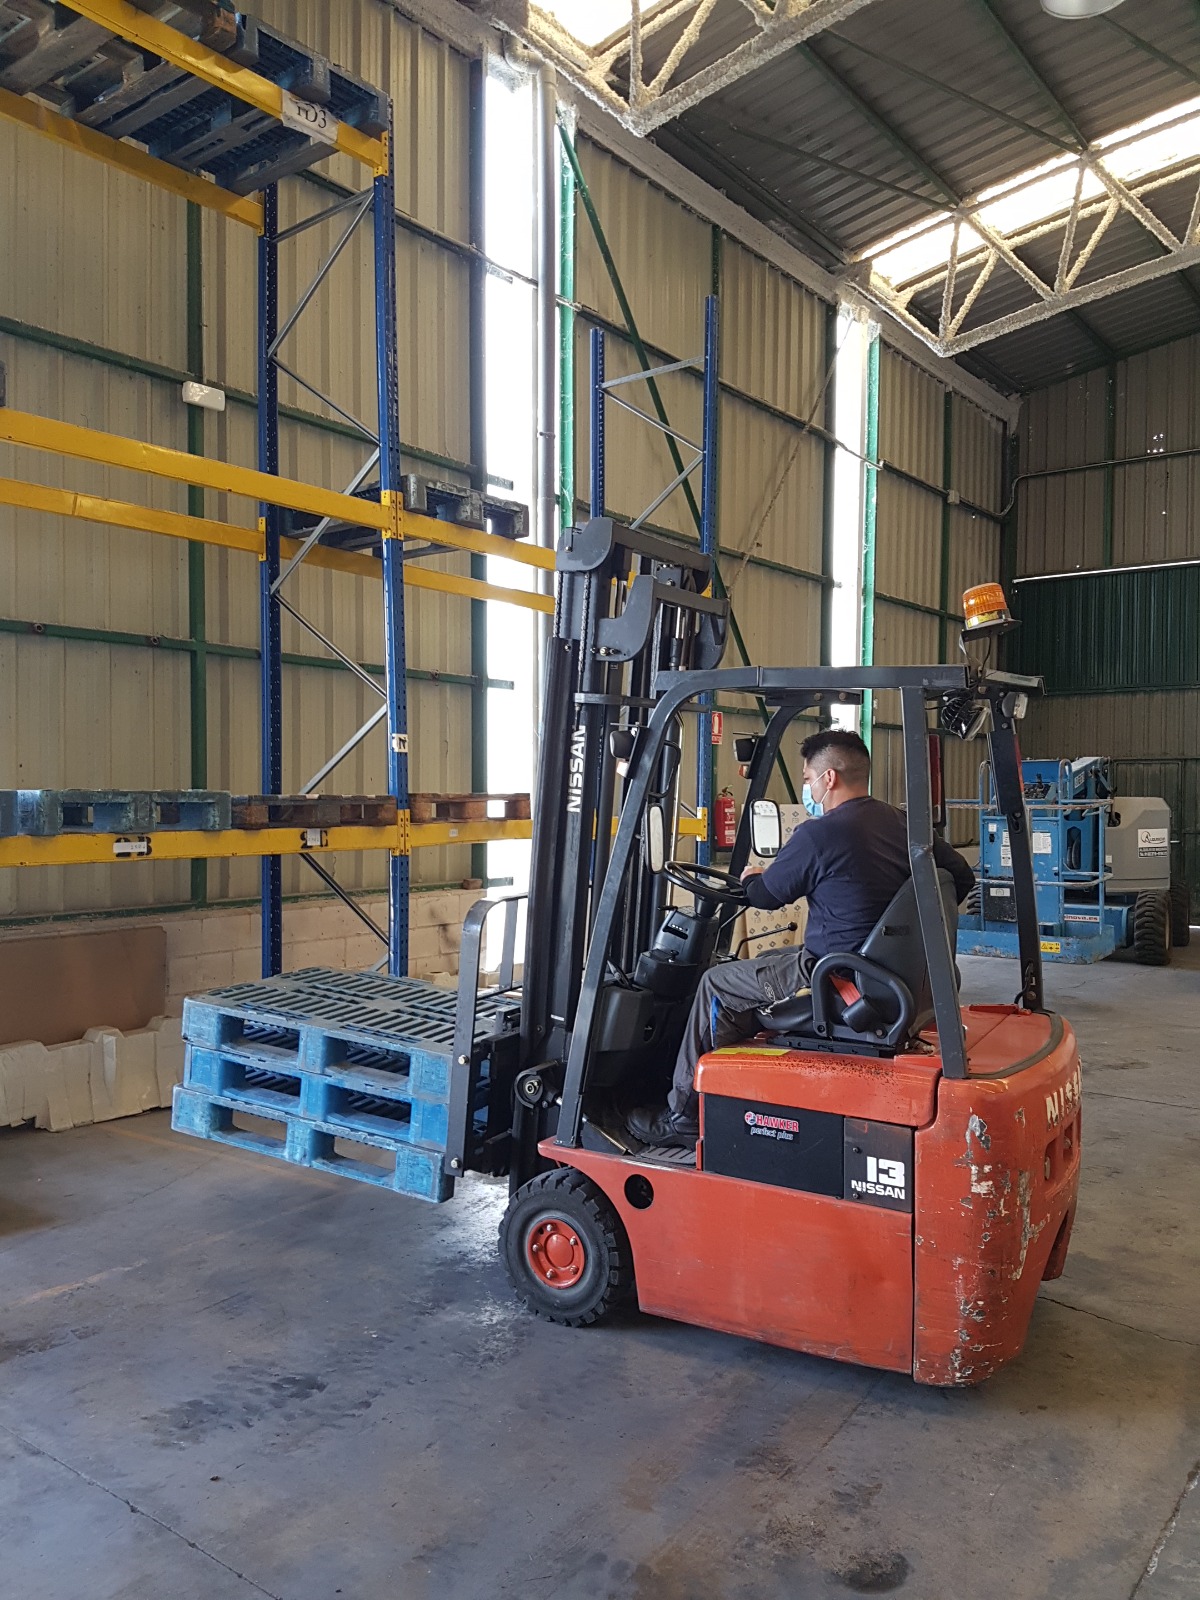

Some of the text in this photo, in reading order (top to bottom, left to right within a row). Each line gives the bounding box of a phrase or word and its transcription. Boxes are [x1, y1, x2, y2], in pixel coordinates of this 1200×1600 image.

[566, 725, 586, 813] NISSAN
[750, 1126, 794, 1140] perfect plus
[755, 1114, 799, 1132] HAWKER
[866, 1155, 905, 1188] 13
[851, 1179, 906, 1200] NISSAN
